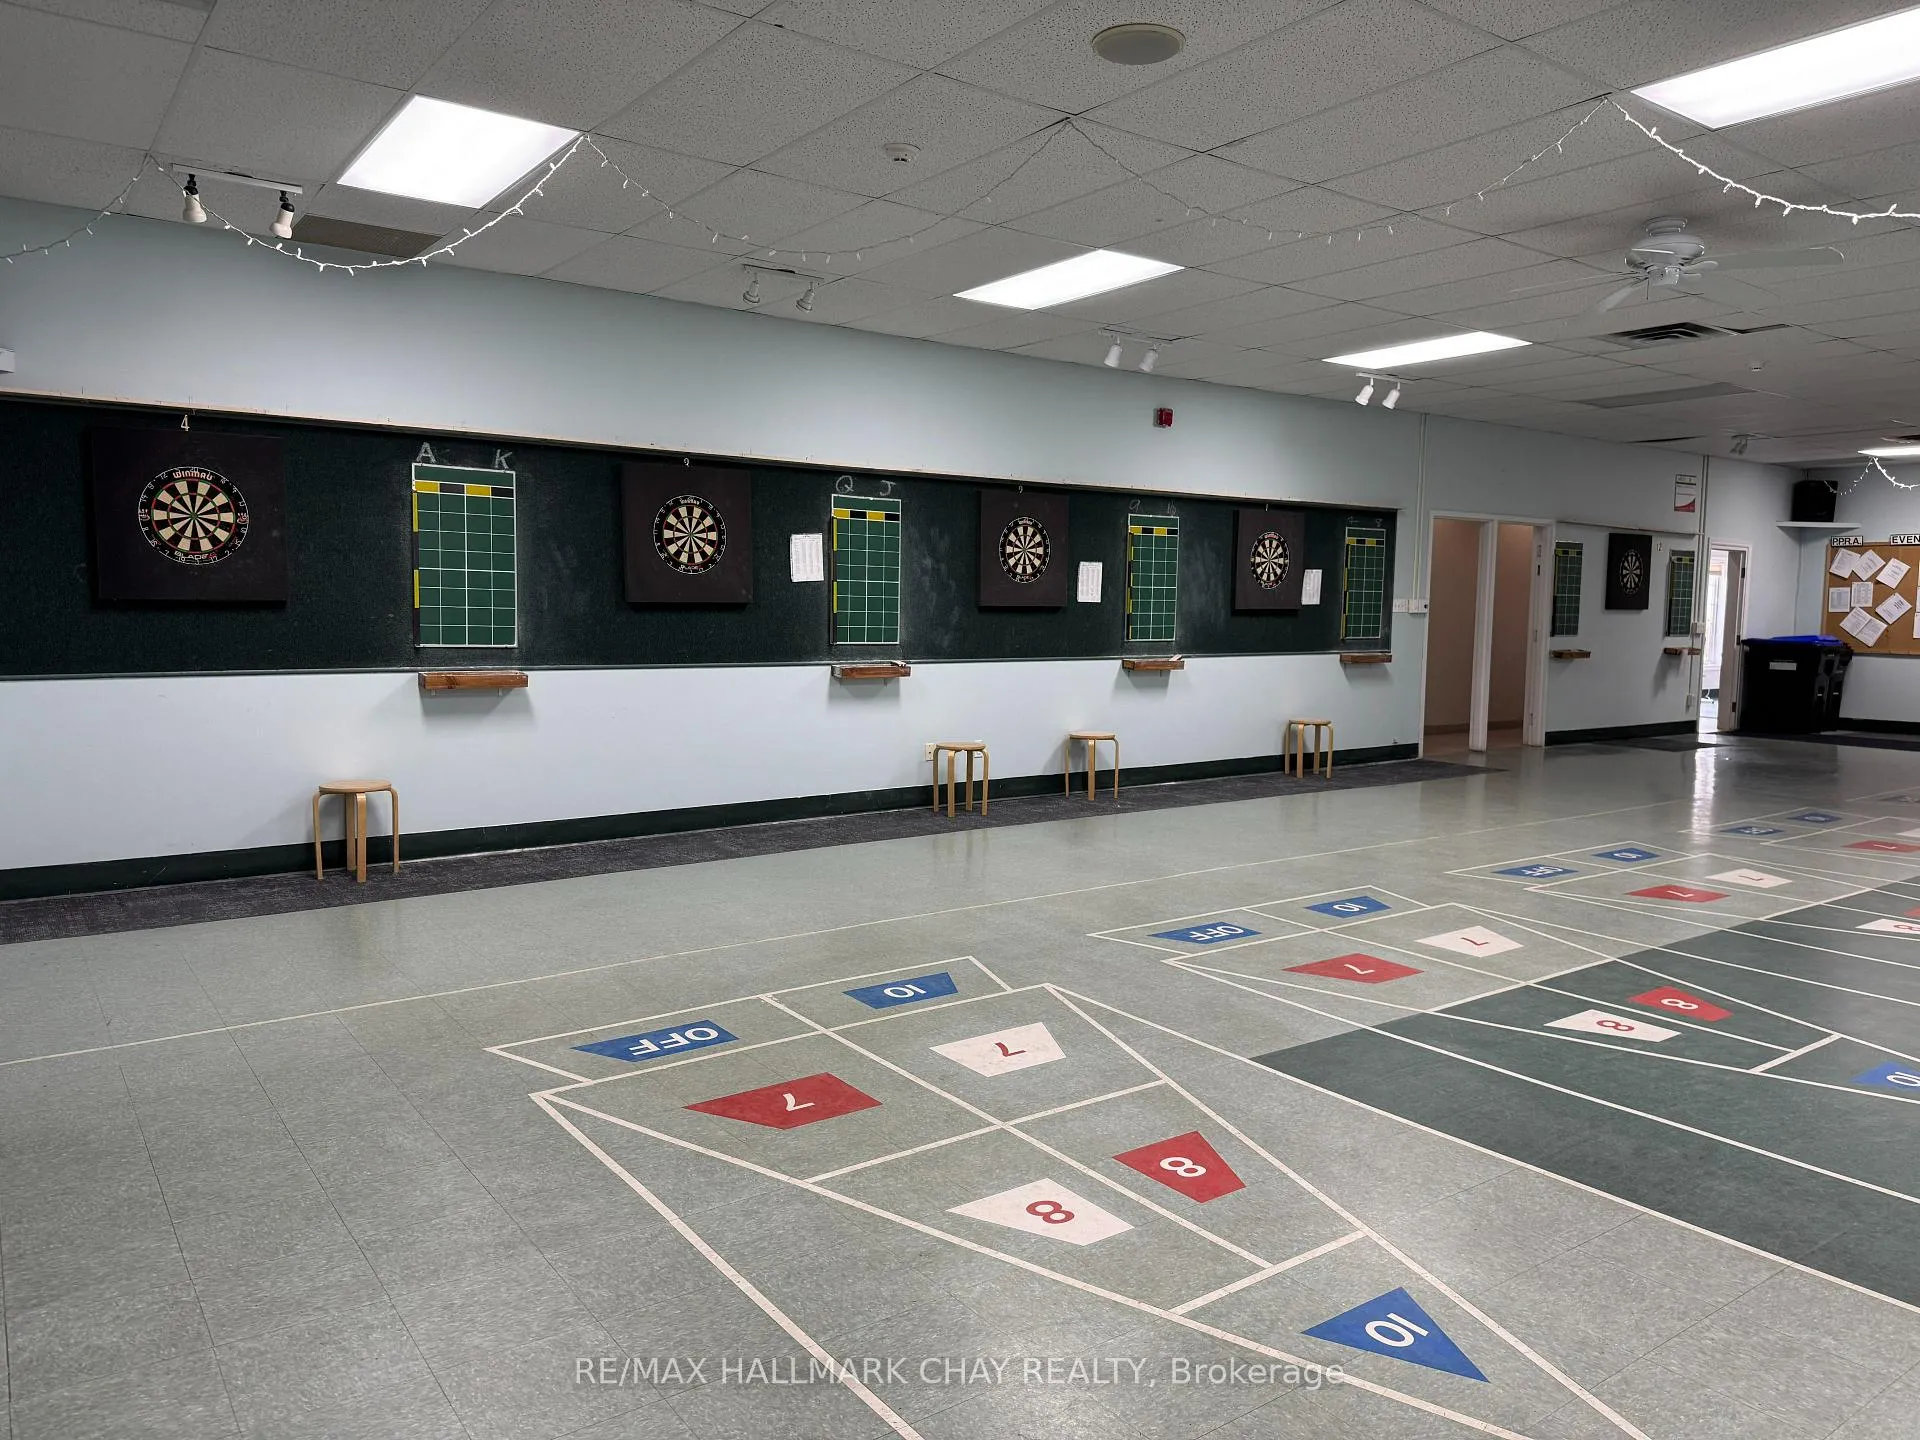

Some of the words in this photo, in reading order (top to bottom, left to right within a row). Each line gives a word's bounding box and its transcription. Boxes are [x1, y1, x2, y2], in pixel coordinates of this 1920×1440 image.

[181, 414, 190, 431] 4
[416, 442, 436, 463] A
[495, 449, 512, 469] K
[836, 475, 854, 493] Q
[880, 480, 896, 496] J
[1892, 535, 1920, 544] EVEN
[1332, 902, 1368, 912] 10
[1189, 926, 1244, 941] OFF
[1460, 937, 1490, 946] 7
[1344, 964, 1375, 975] 7
[883, 984, 927, 999] 10
[1661, 998, 1698, 1010] 8
[1596, 1020, 1634, 1031] 8
[629, 1027, 719, 1056] OFF
[995, 1042, 1026, 1057] 7
[783, 1093, 815, 1112] 7
[1159, 1156, 1206, 1177] 8
[1026, 1200, 1074, 1224] 8
[1365, 1312, 1429, 1347] 10
